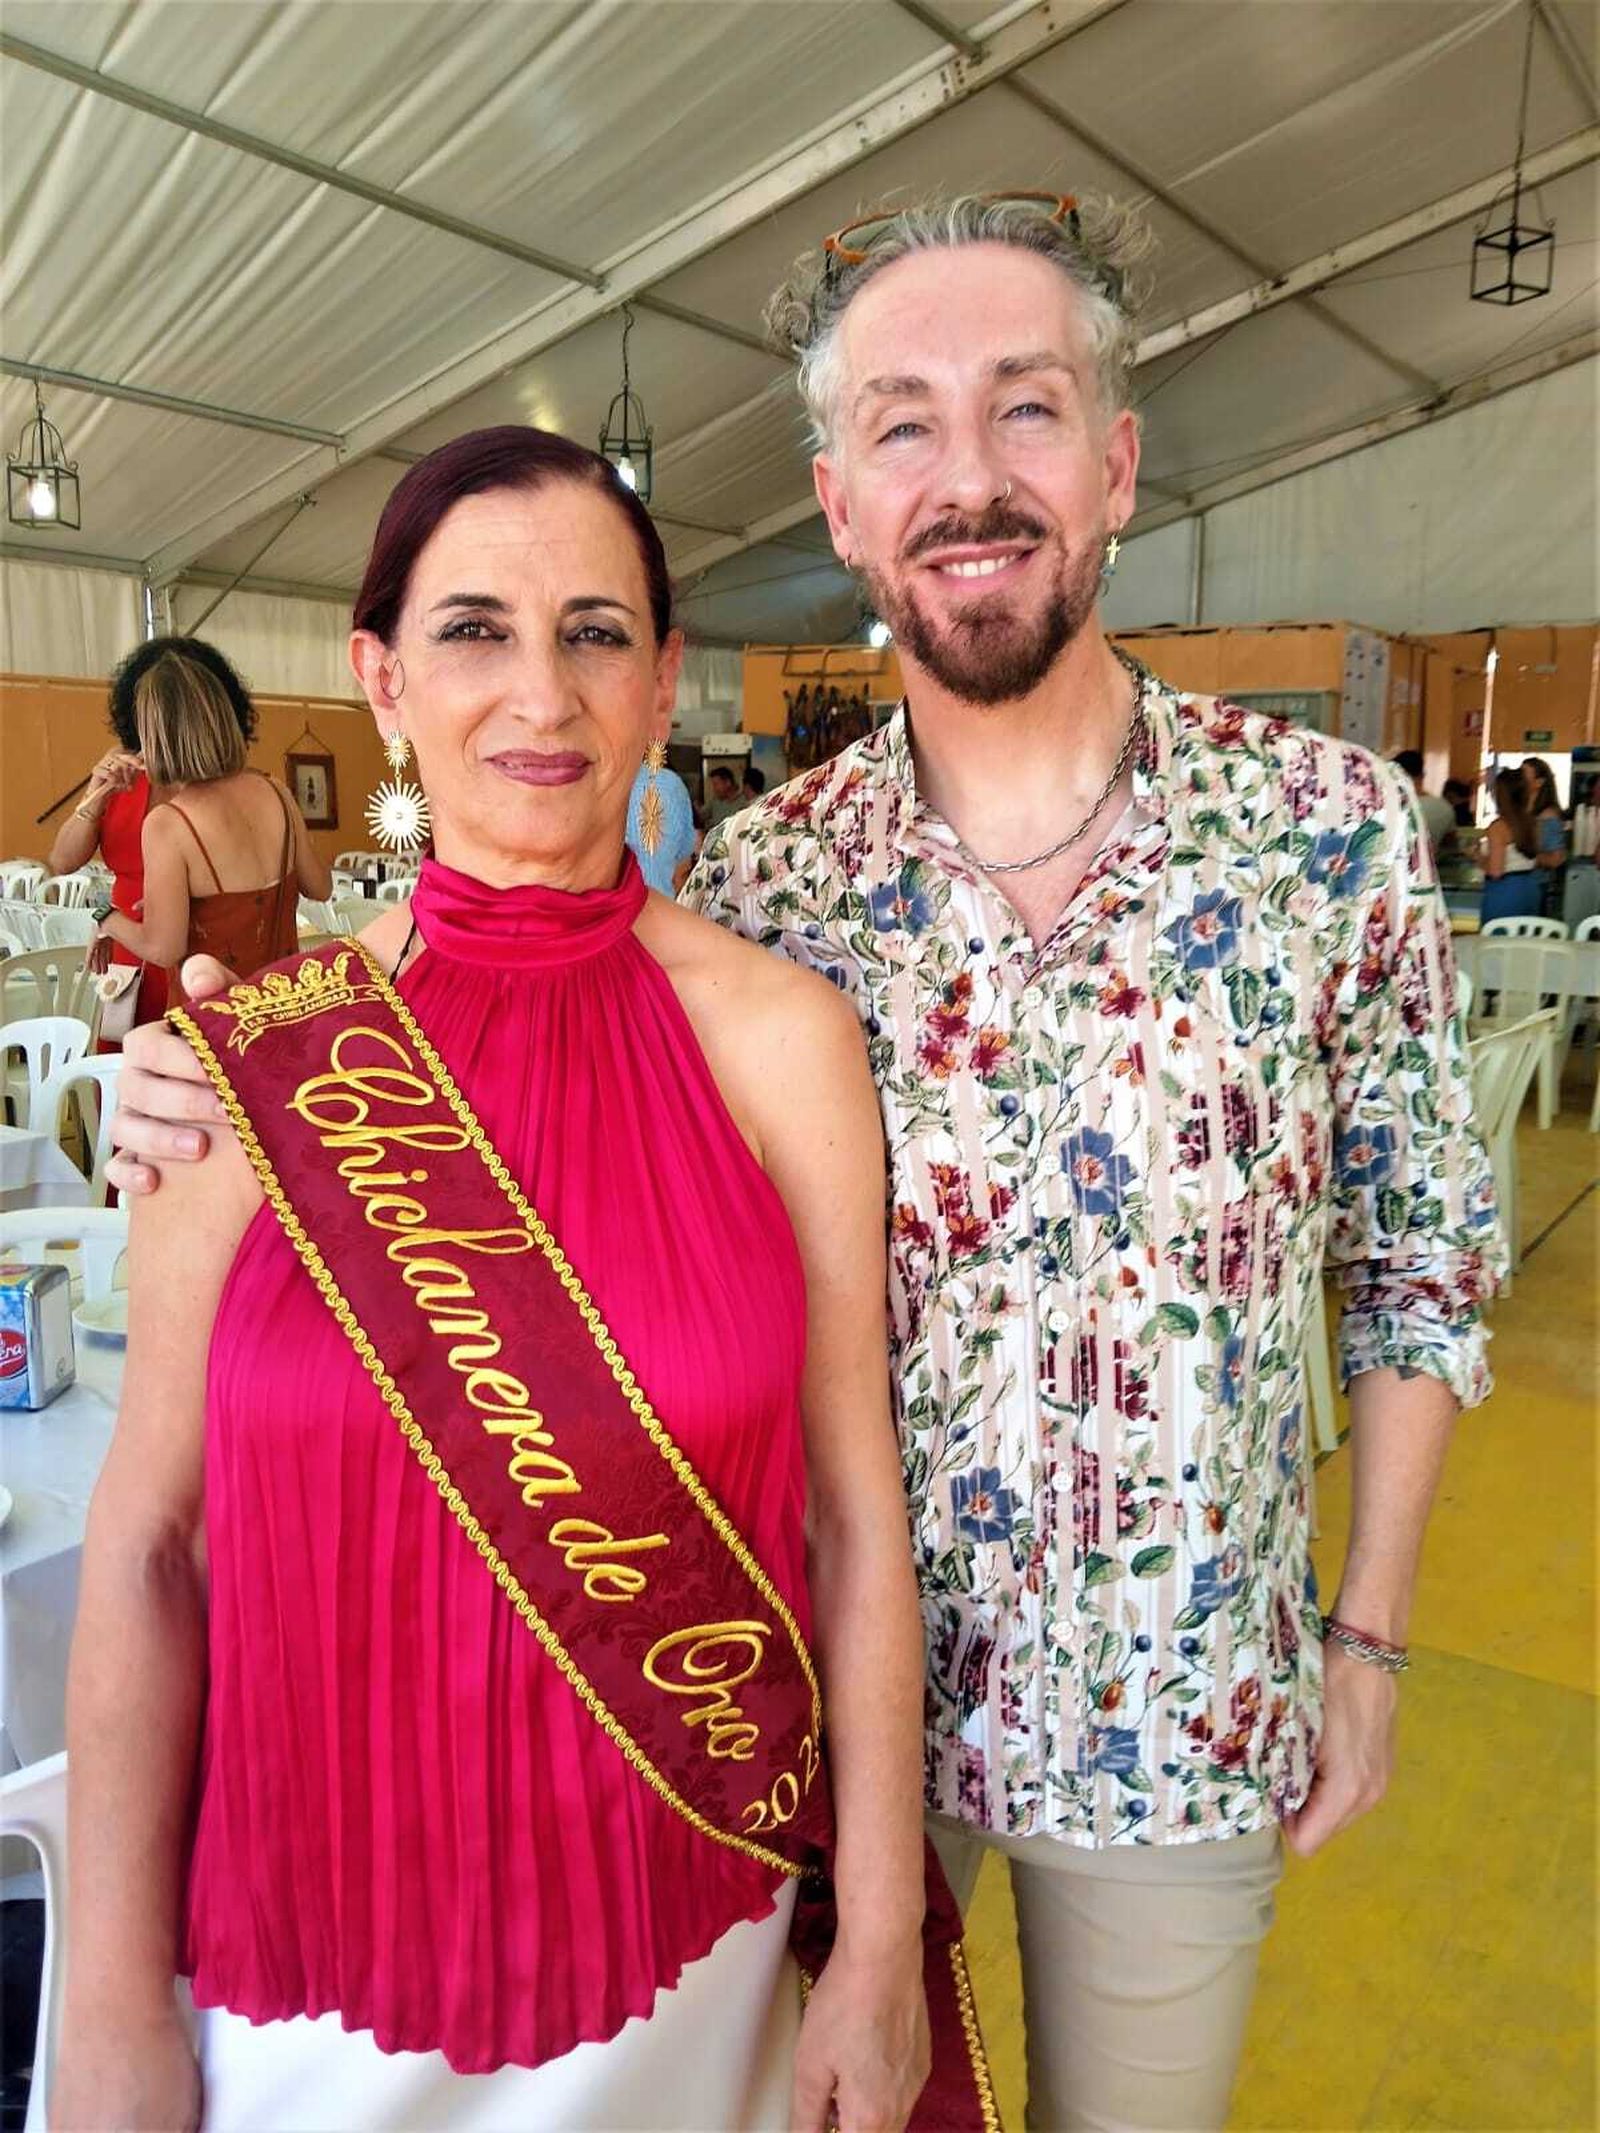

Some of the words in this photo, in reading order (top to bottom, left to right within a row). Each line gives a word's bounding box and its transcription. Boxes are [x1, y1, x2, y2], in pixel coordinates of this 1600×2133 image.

[285, 1026, 582, 1507] Chiclanera
[548, 1517, 671, 1602] de
[642, 1620, 772, 1760] Oro
